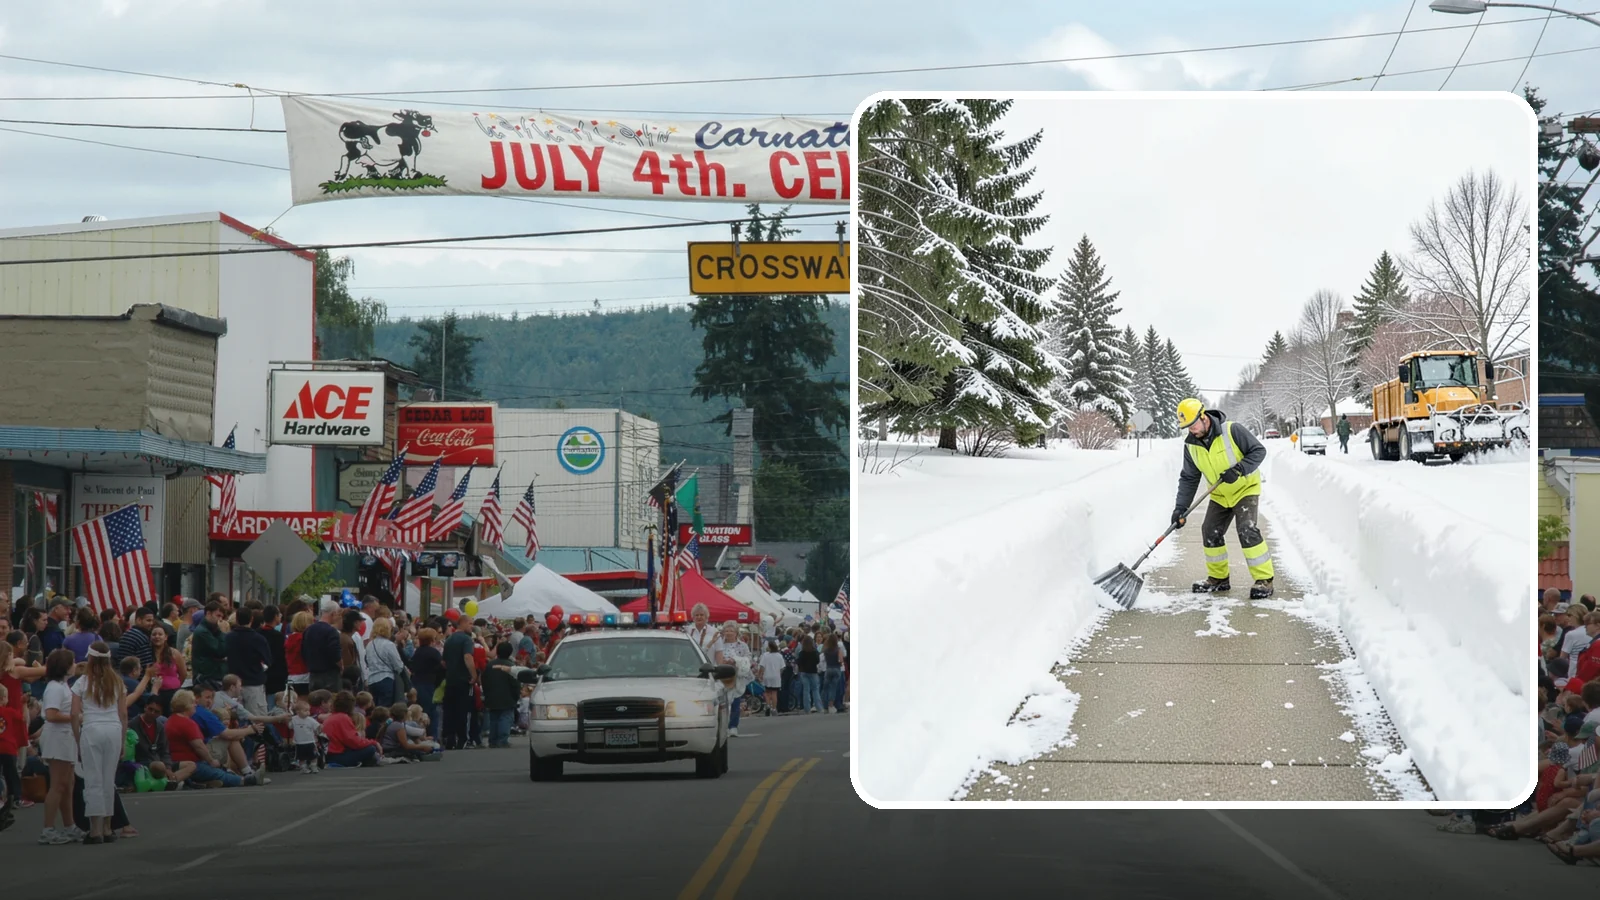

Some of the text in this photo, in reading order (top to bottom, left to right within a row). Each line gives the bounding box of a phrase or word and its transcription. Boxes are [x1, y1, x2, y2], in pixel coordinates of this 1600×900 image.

[481, 141, 605, 192] JULY
[632, 150, 746, 197] 4th.
[697, 254, 850, 279] CROSSWA
[282, 380, 373, 420] ACE
[405, 409, 485, 422] CEDAR LOG
[283, 421, 370, 436] Hardware
[416, 428, 476, 446] Coca-Cola
[353, 467, 386, 480] Simpl
[96, 485, 124, 494] Vincent
[126, 486, 136, 494] de
[138, 486, 155, 495] Paul
[213, 516, 330, 535] HARDARE
[688, 526, 741, 535] CRNATION
[699, 535, 730, 543] GLASS
